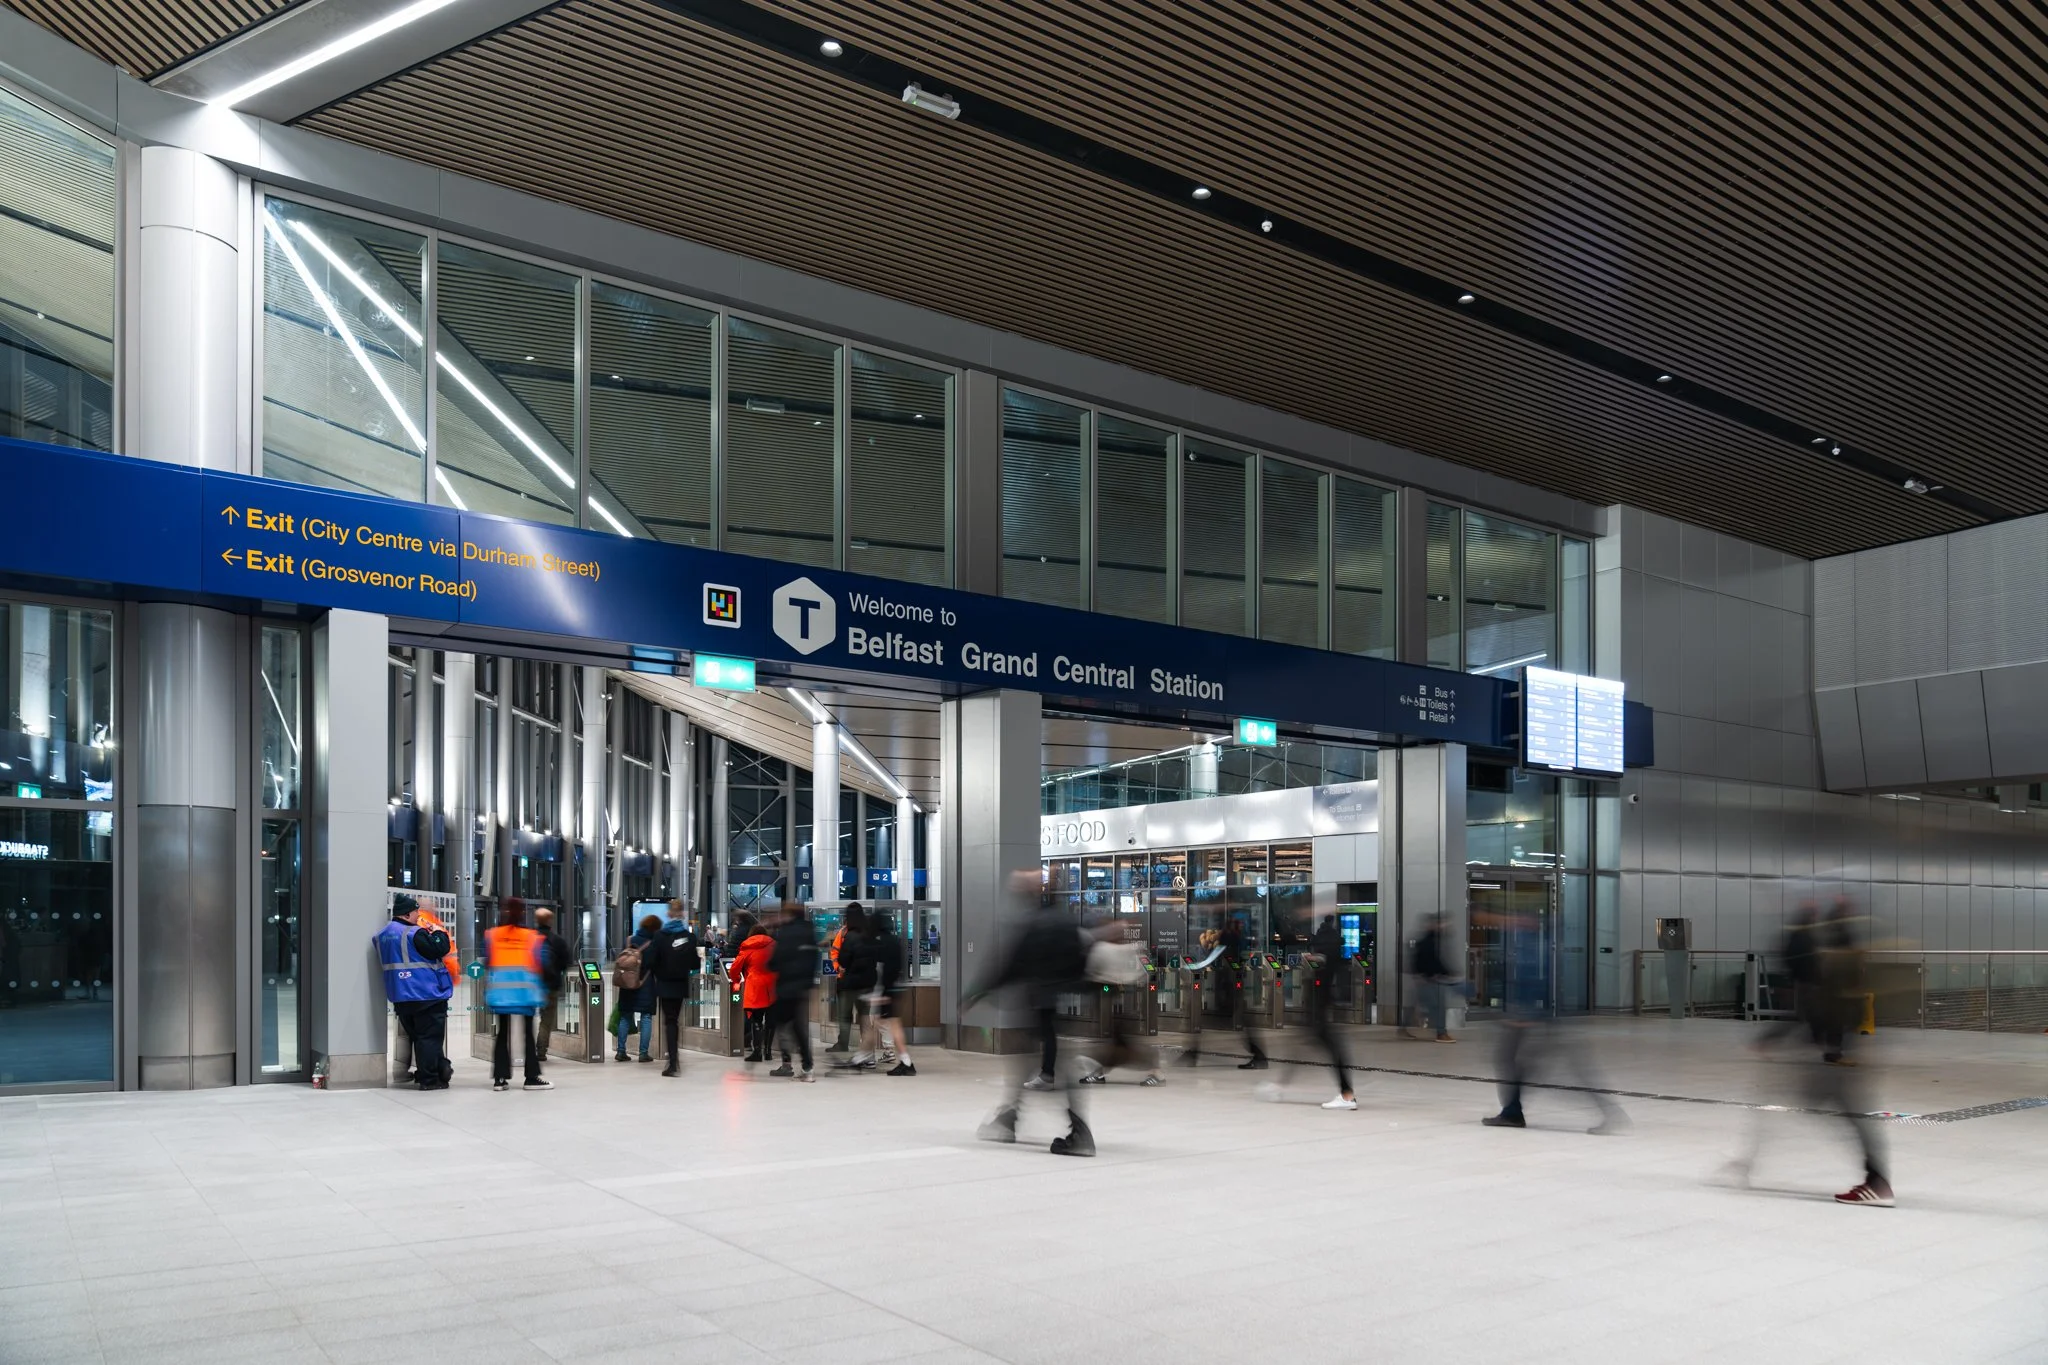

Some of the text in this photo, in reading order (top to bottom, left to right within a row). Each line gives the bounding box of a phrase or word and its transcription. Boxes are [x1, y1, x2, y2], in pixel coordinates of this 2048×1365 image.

[246, 507, 601, 582] Exit (City Centre via Durham Street)
[246, 549, 477, 602] Exit (Grosvenor Road)
[848, 591, 957, 627] Welcome to
[848, 626, 1223, 701] Belfast Grand Central Station
[1427, 698, 1448, 711] Toilets
[1435, 687, 1448, 699] Bus
[1429, 711, 1448, 723] Retail
[1057, 820, 1106, 845] FOOD
[882, 873, 888, 881] 2
